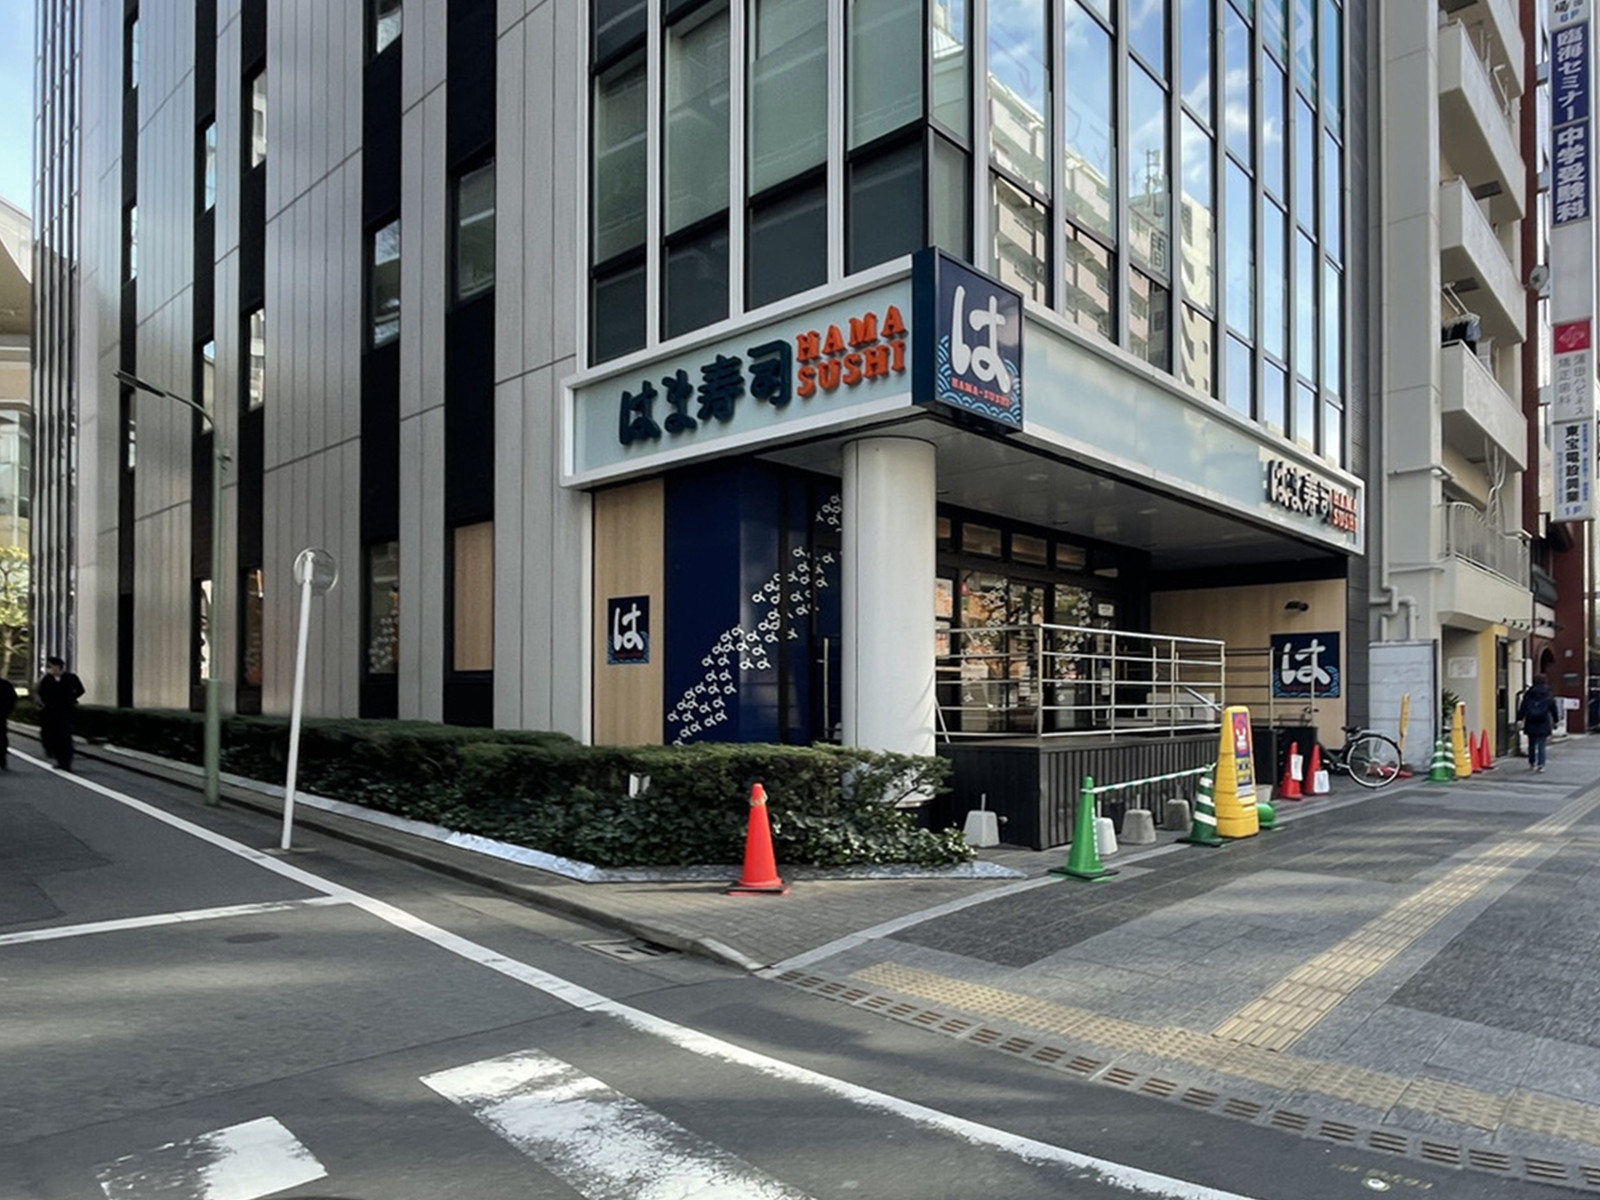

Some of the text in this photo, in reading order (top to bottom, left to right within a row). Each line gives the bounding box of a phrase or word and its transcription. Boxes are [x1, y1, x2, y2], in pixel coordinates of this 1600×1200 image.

[1557, 26, 1583, 121] 臨海セミナー
[1557, 127, 1586, 222] 中学受験科
[796, 305, 908, 364] HAMA
[951, 285, 1012, 394] は
[618, 340, 793, 446] はま寿司
[796, 339, 907, 399] SUSHI
[1267, 460, 1331, 524] はま寿司
[613, 603, 645, 651] は
[1281, 638, 1332, 685] は
